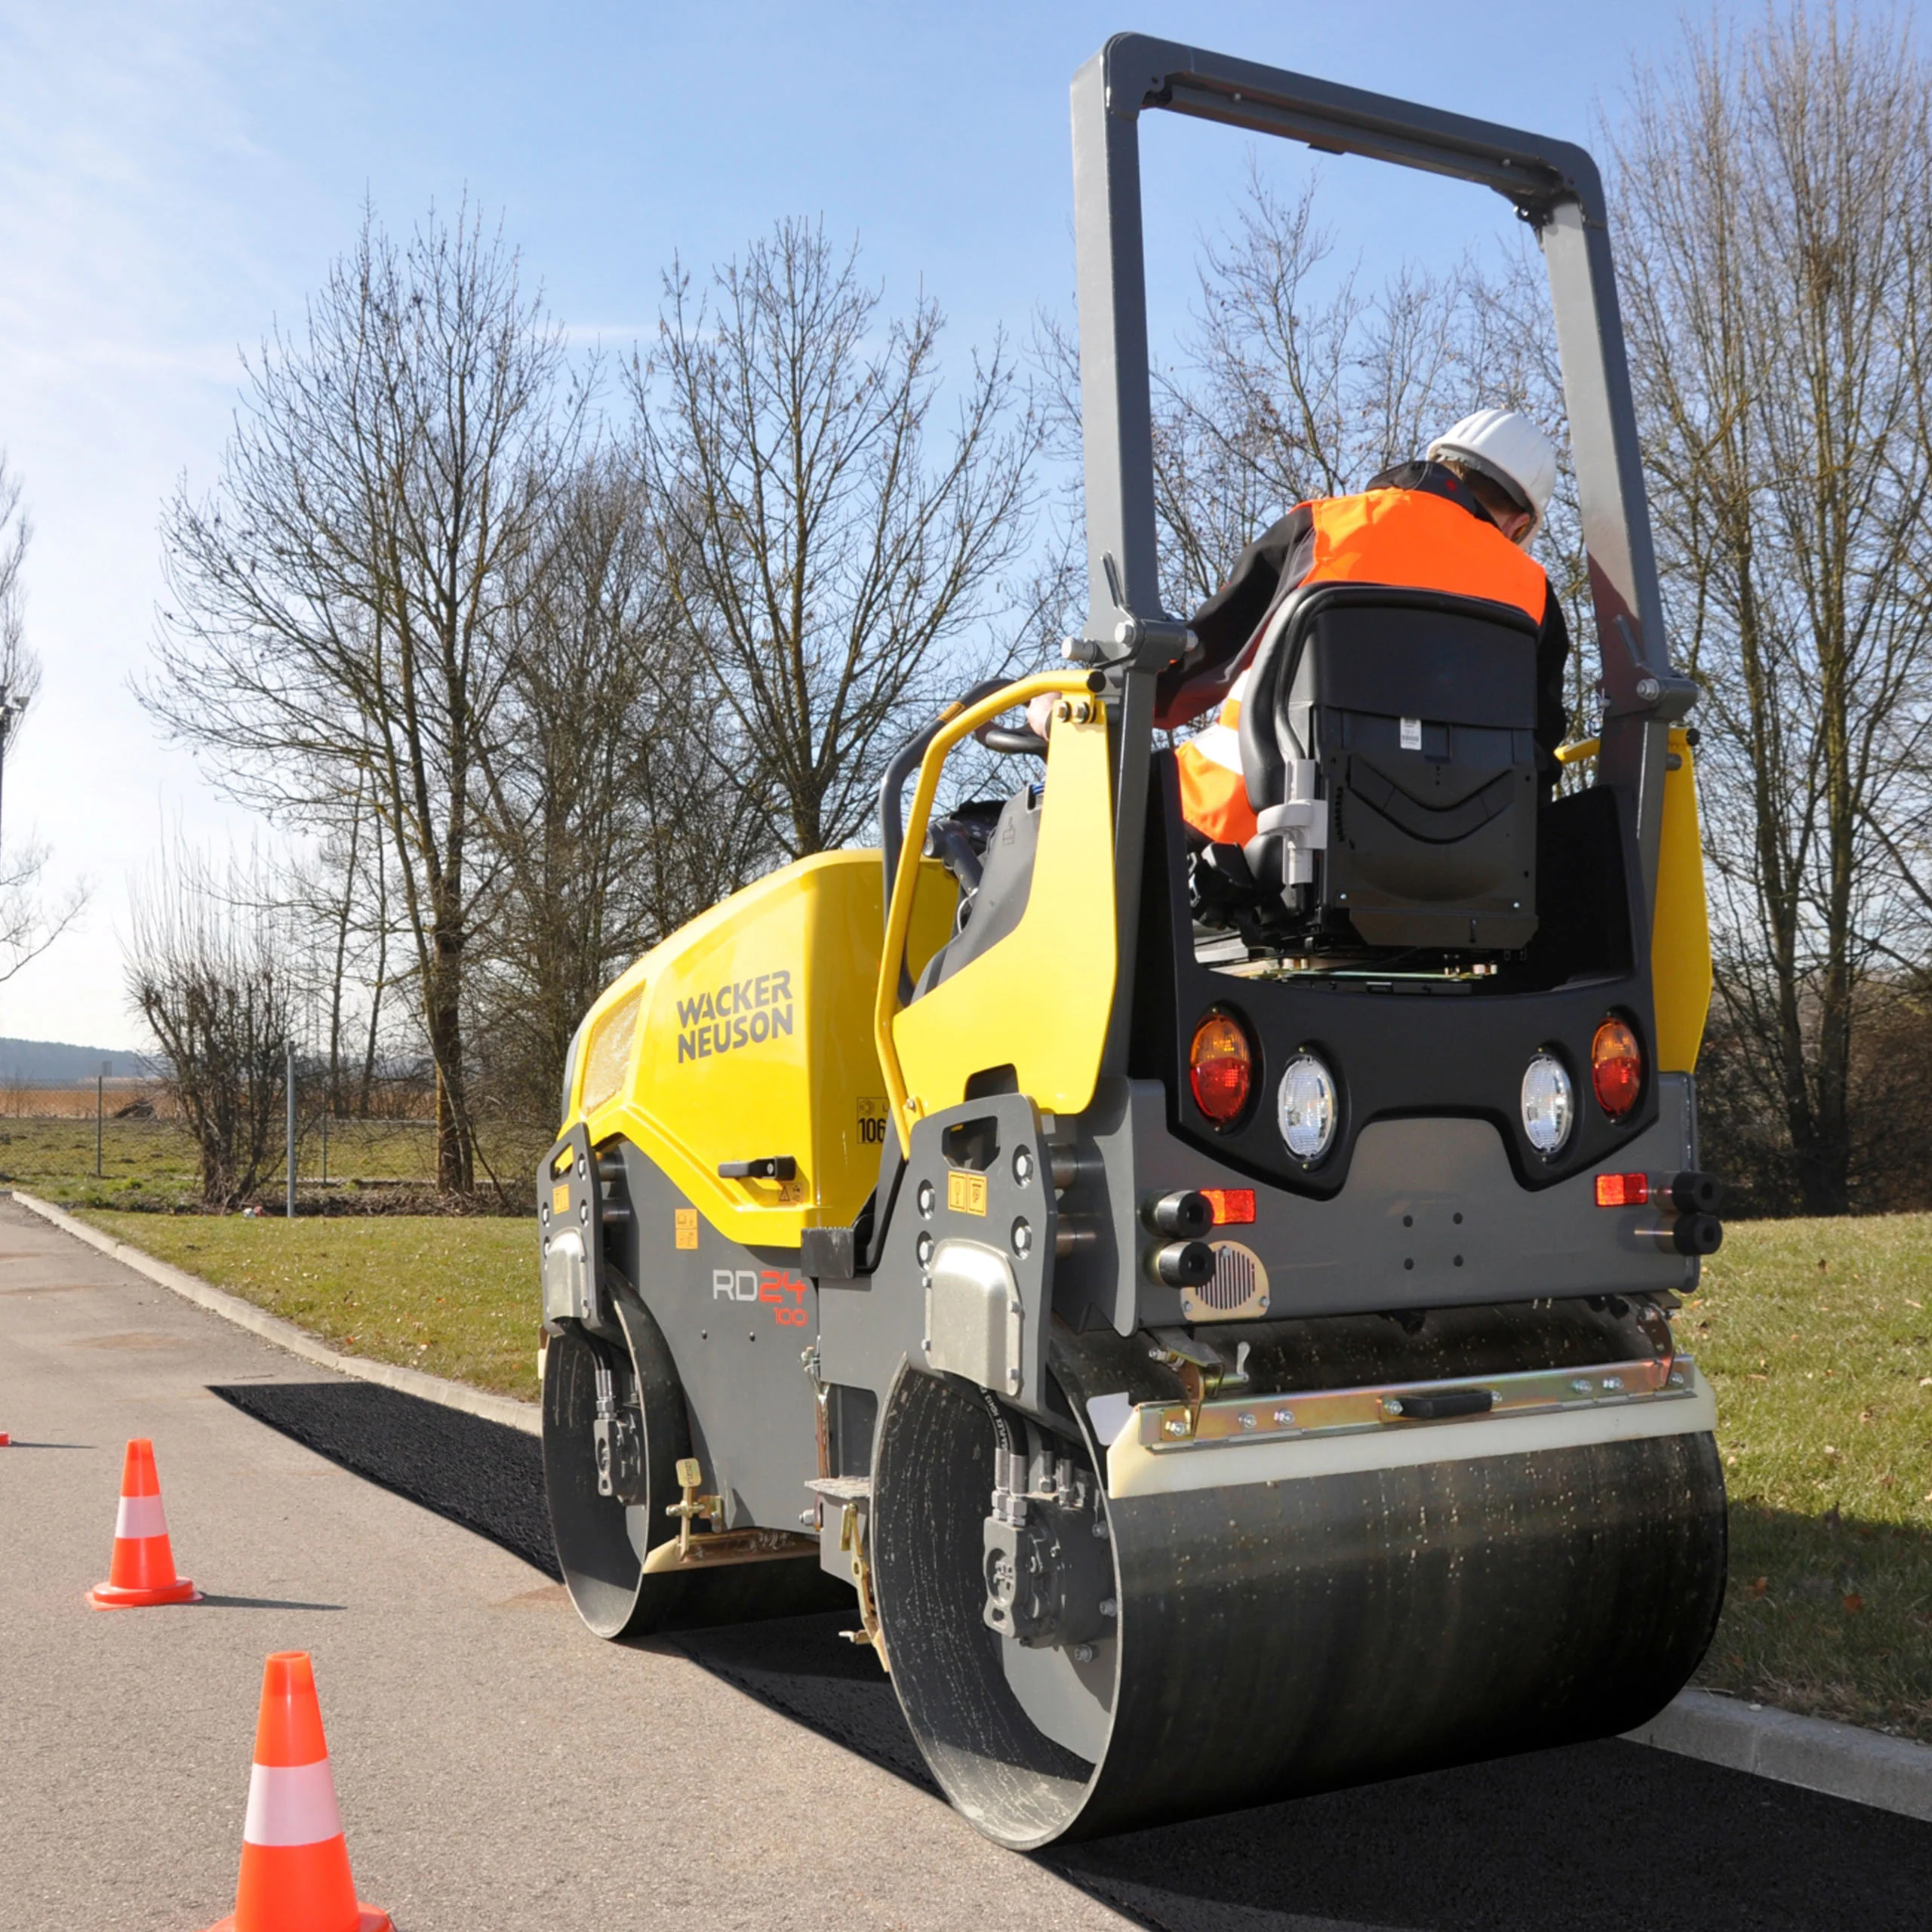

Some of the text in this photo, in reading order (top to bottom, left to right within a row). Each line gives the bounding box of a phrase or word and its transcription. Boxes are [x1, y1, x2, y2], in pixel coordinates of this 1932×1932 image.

[676, 970, 792, 1029] WACKER
[678, 1003, 793, 1063] NEUSON
[858, 1118, 887, 1143] 106
[712, 1269, 807, 1305] RD24
[773, 1306, 808, 1327] 100
